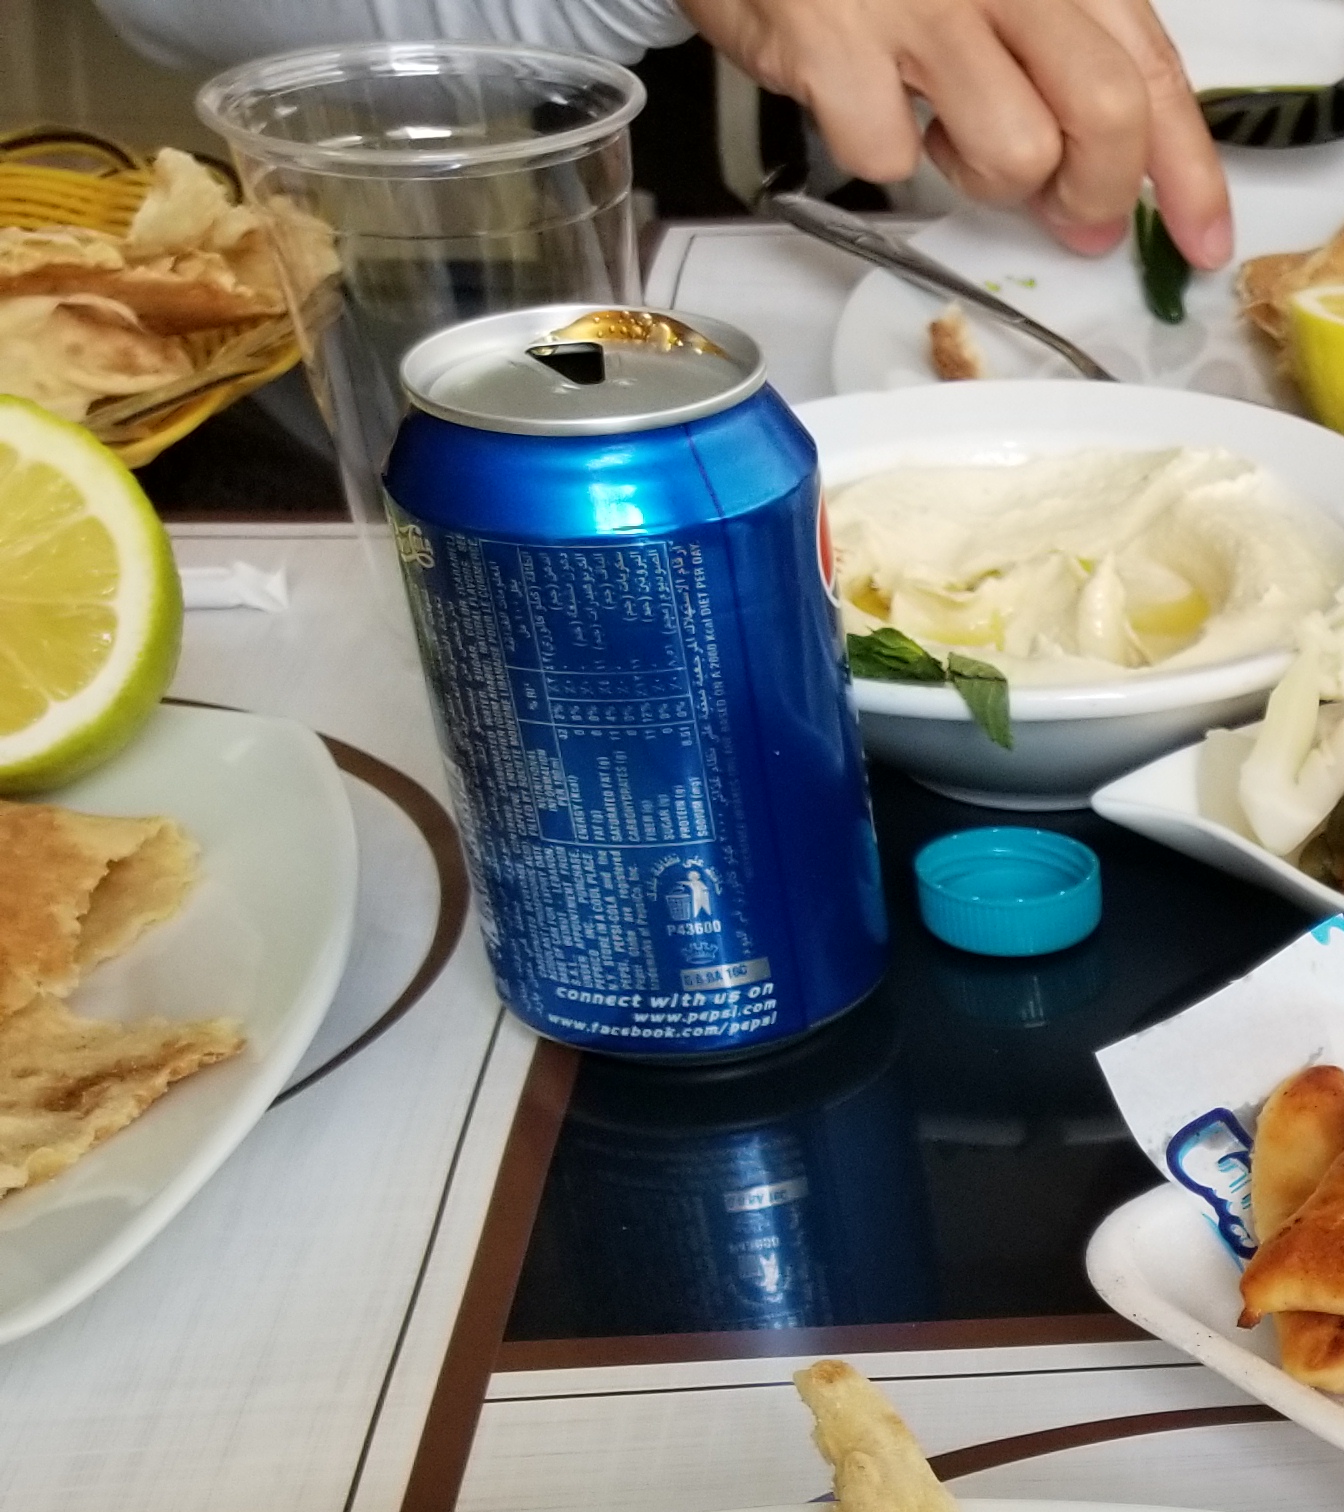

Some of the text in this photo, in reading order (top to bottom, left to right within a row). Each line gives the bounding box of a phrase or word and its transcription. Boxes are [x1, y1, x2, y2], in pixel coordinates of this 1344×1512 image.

[693, 567, 706, 589] PER
[696, 592, 712, 616] DIET
[713, 681, 724, 696] ON
[526, 750, 547, 809] NUTRITIONAL
[537, 749, 558, 812] INFORMATION
[598, 771, 612, 788] FAT
[556, 788, 569, 806] PER
[615, 766, 640, 842] CARBOHYDRATES
[524, 805, 539, 836] FILLED
[572, 803, 589, 840] ENERGY
[603, 790, 622, 842] SATURATED
[642, 815, 657, 841] FIBER
[658, 808, 675, 840] SUGAR
[675, 800, 692, 838] PROTEIN
[692, 800, 708, 837] SODIUM
[591, 825, 605, 841] FAT
[538, 870, 553, 904] EXPIRY
[608, 850, 630, 899] registered
[590, 887, 604, 912] COOL
[556, 846, 593, 987] UNDER APPOINTMENT FROM
[596, 923, 607, 934] IN
[622, 907, 634, 923] are
[667, 919, 722, 936] P43600
[550, 926, 561, 945] CAN
[598, 936, 614, 966] STORE
[557, 960, 569, 983] BASE
[556, 982, 775, 1009] connect with us on
[548, 1011, 778, 1039] www.facebook.com/pepsi
[633, 999, 777, 1026] www.pepsi.com
